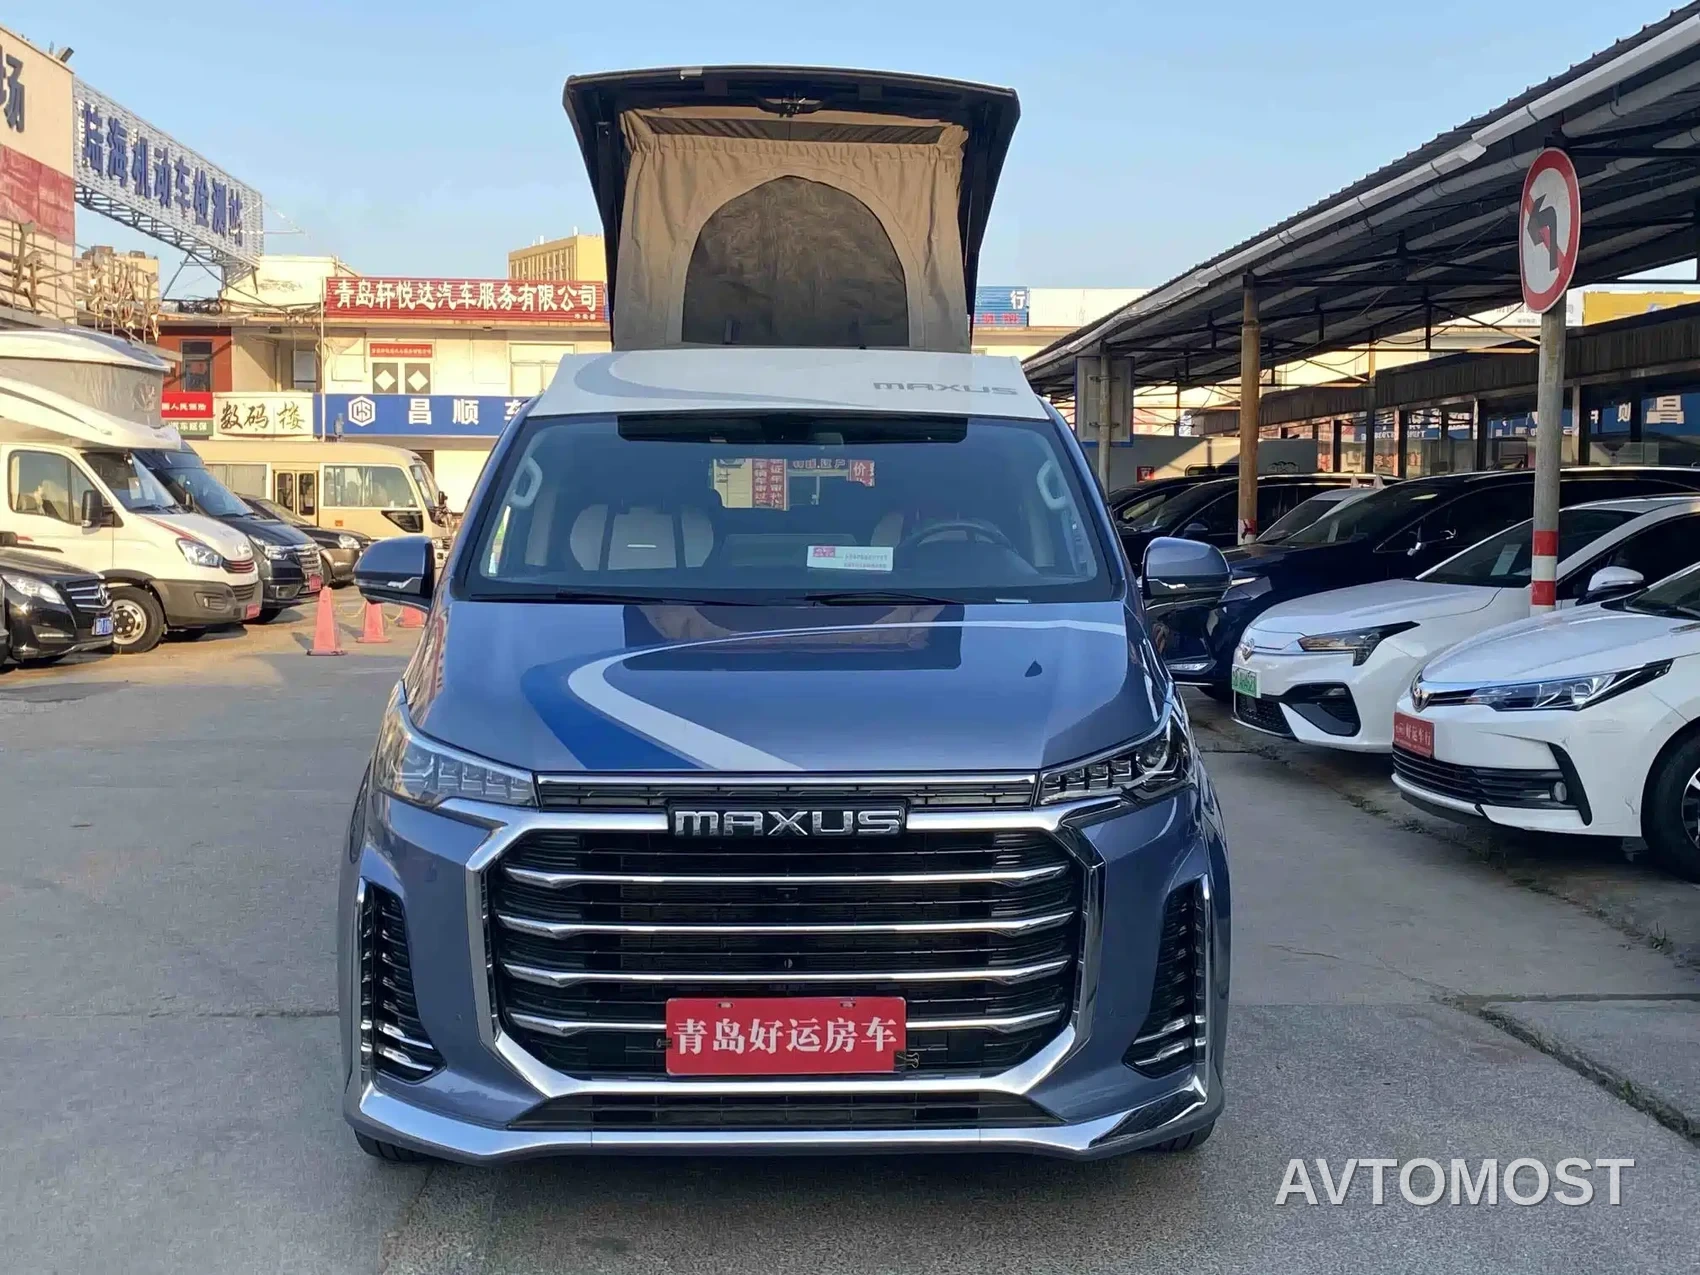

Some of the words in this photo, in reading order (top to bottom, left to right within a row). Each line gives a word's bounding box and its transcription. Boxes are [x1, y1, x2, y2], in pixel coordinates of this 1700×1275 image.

[335, 281, 597, 312] 青岛轩悦达汽车服务有限公司
[873, 382, 1018, 395] MAXUS
[220, 401, 305, 430] 数码楼
[674, 810, 900, 836] MAXUS
[673, 1017, 897, 1054] 青岛好运房车
